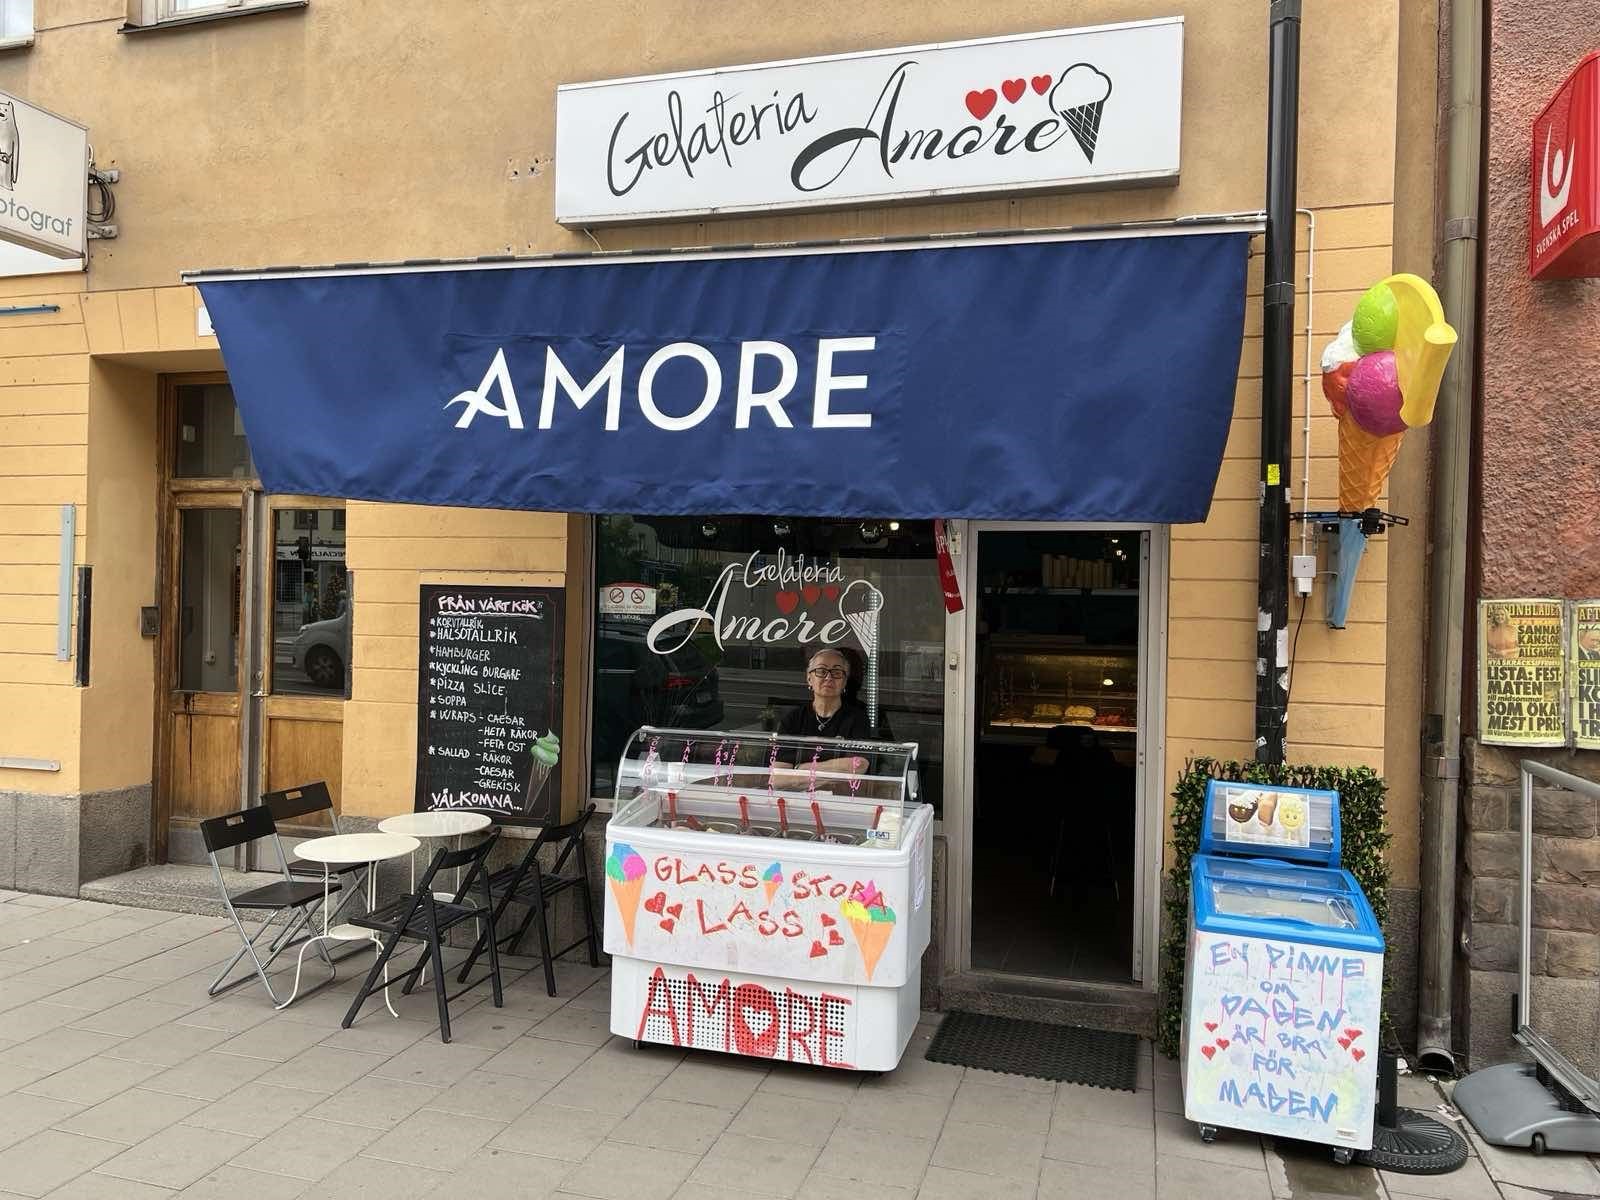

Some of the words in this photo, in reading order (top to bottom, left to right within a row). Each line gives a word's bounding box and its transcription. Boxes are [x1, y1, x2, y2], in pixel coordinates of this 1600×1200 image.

[607, 86, 818, 196] Gelateria
[790, 61, 1069, 192] Amore
[1536, 224, 1561, 258] SVENSKA
[1562, 209, 1579, 234] SPEL
[443, 336, 876, 431] AMORE
[744, 547, 845, 590] Gelateria
[438, 594, 475, 611] FRÅN
[479, 597, 510, 613] VÅRT
[512, 599, 539, 613] KÖK
[647, 563, 849, 655] Amore
[435, 645, 490, 661] HAMBURGER
[435, 660, 478, 676] KYCKLING
[1488, 667, 1533, 680] LISTA:
[1536, 668, 1562, 680] FEST-
[436, 677, 465, 692] PIZZA
[473, 682, 506, 695] SLICE
[1488, 681, 1542, 695] MATEN
[437, 695, 467, 707] SOPPA
[1488, 702, 1523, 715] SOM
[440, 710, 477, 723] WRAPS
[487, 713, 525, 727] CAESAR
[1488, 716, 1526, 730] MEST
[1529, 717, 1533, 730] I
[1537, 717, 1560, 731] PRIS
[483, 726, 506, 738] HETA
[438, 747, 470, 759] SALLAD
[483, 739, 505, 750] FETA
[507, 741, 526, 752] OST
[479, 766, 515, 779] CAESAR
[478, 778, 520, 793] GREKISK
[654, 856, 760, 888] GLASS
[792, 870, 886, 914] STORA
[697, 898, 804, 937] LASS
[1210, 941, 1249, 966] EN
[1266, 944, 1365, 978] PINNE
[1260, 981, 1299, 1001] OM
[635, 967, 857, 1069] AMORE
[1221, 994, 1346, 1031] DAGEN
[1232, 1024, 1265, 1047] ÄR
[1276, 1032, 1327, 1060] BRA
[1253, 1050, 1296, 1080] FÖR
[1219, 1080, 1338, 1123] MAGEN
